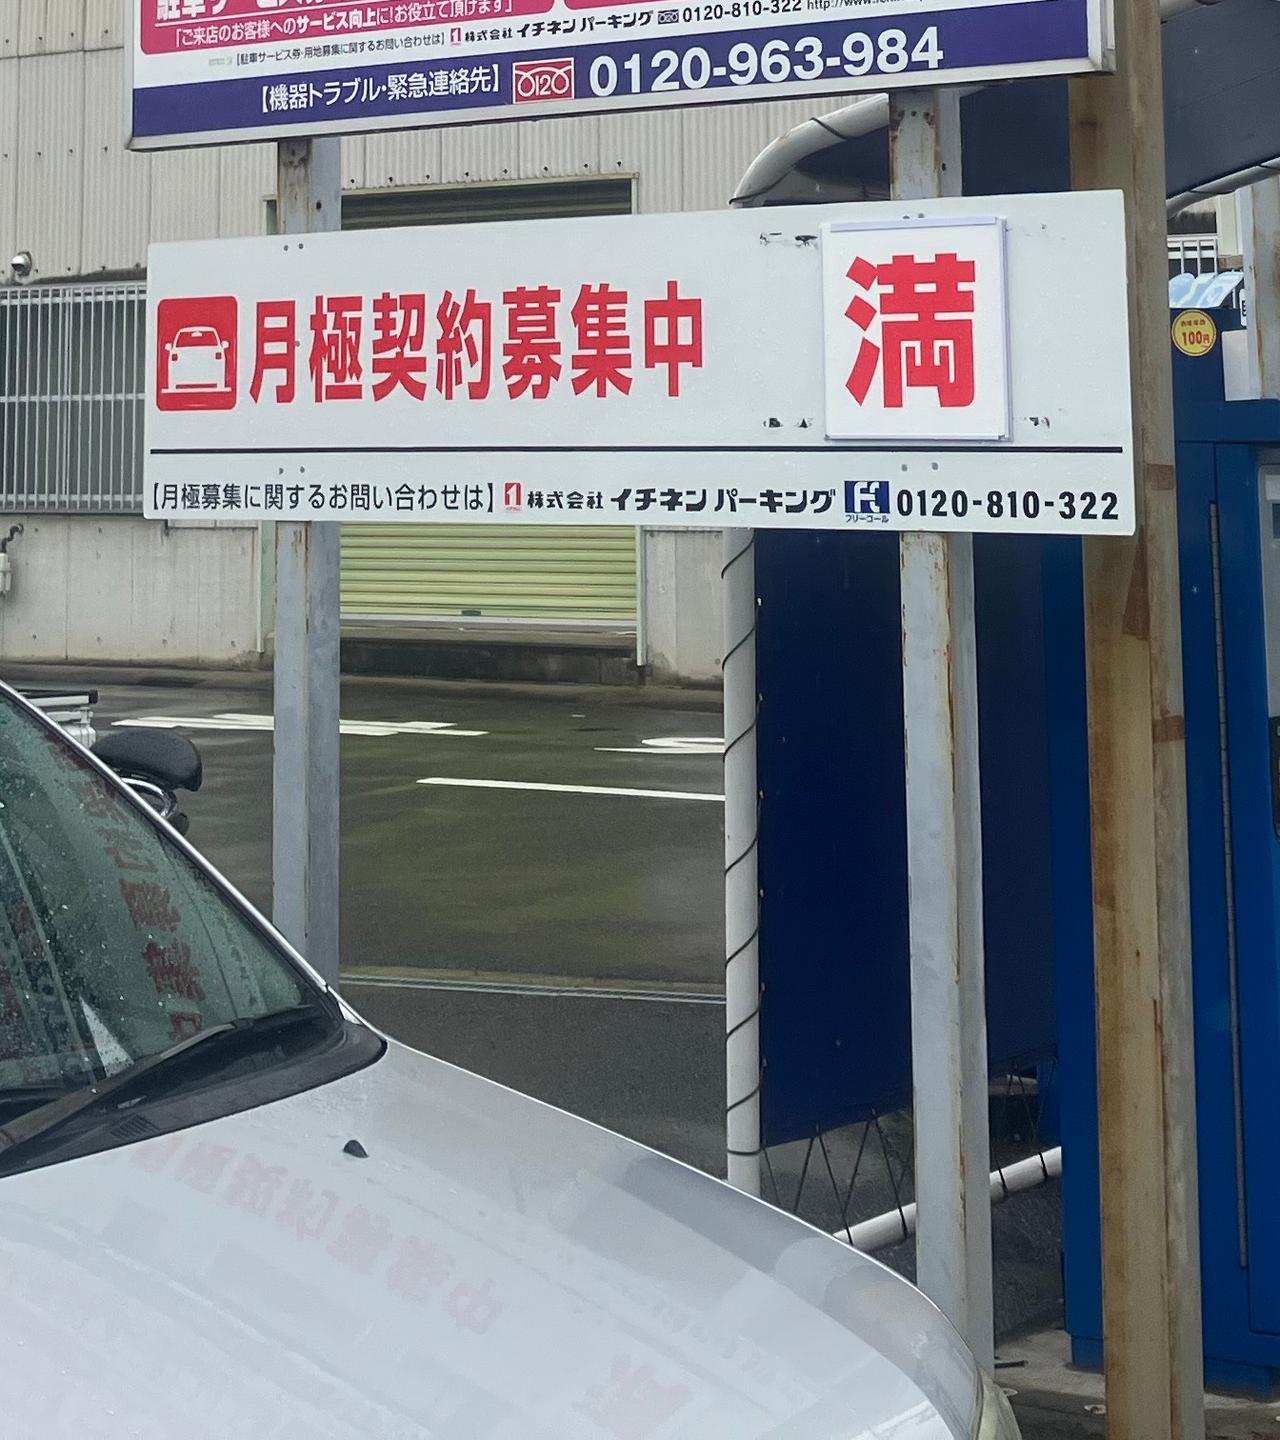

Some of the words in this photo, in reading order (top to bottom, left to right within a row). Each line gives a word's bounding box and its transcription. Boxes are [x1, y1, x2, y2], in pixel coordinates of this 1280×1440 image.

[465, 28, 513, 43] 株式会社
[517, 19, 576, 38] イチネン
[580, 11, 653, 32] パーキング
[589, 26, 944, 97] 0120-963-984
[249, 280, 703, 405] 月極契約募集中
[845, 253, 977, 408] 満
[154, 482, 493, 511] 【月極募集に関するお問い合わせは】
[527, 490, 603, 510] 株式会社
[610, 488, 707, 513] イチネン
[715, 488, 836, 513] パーキング
[897, 489, 1119, 520] 0120-810-322
[845, 514, 889, 523] フリーコール
